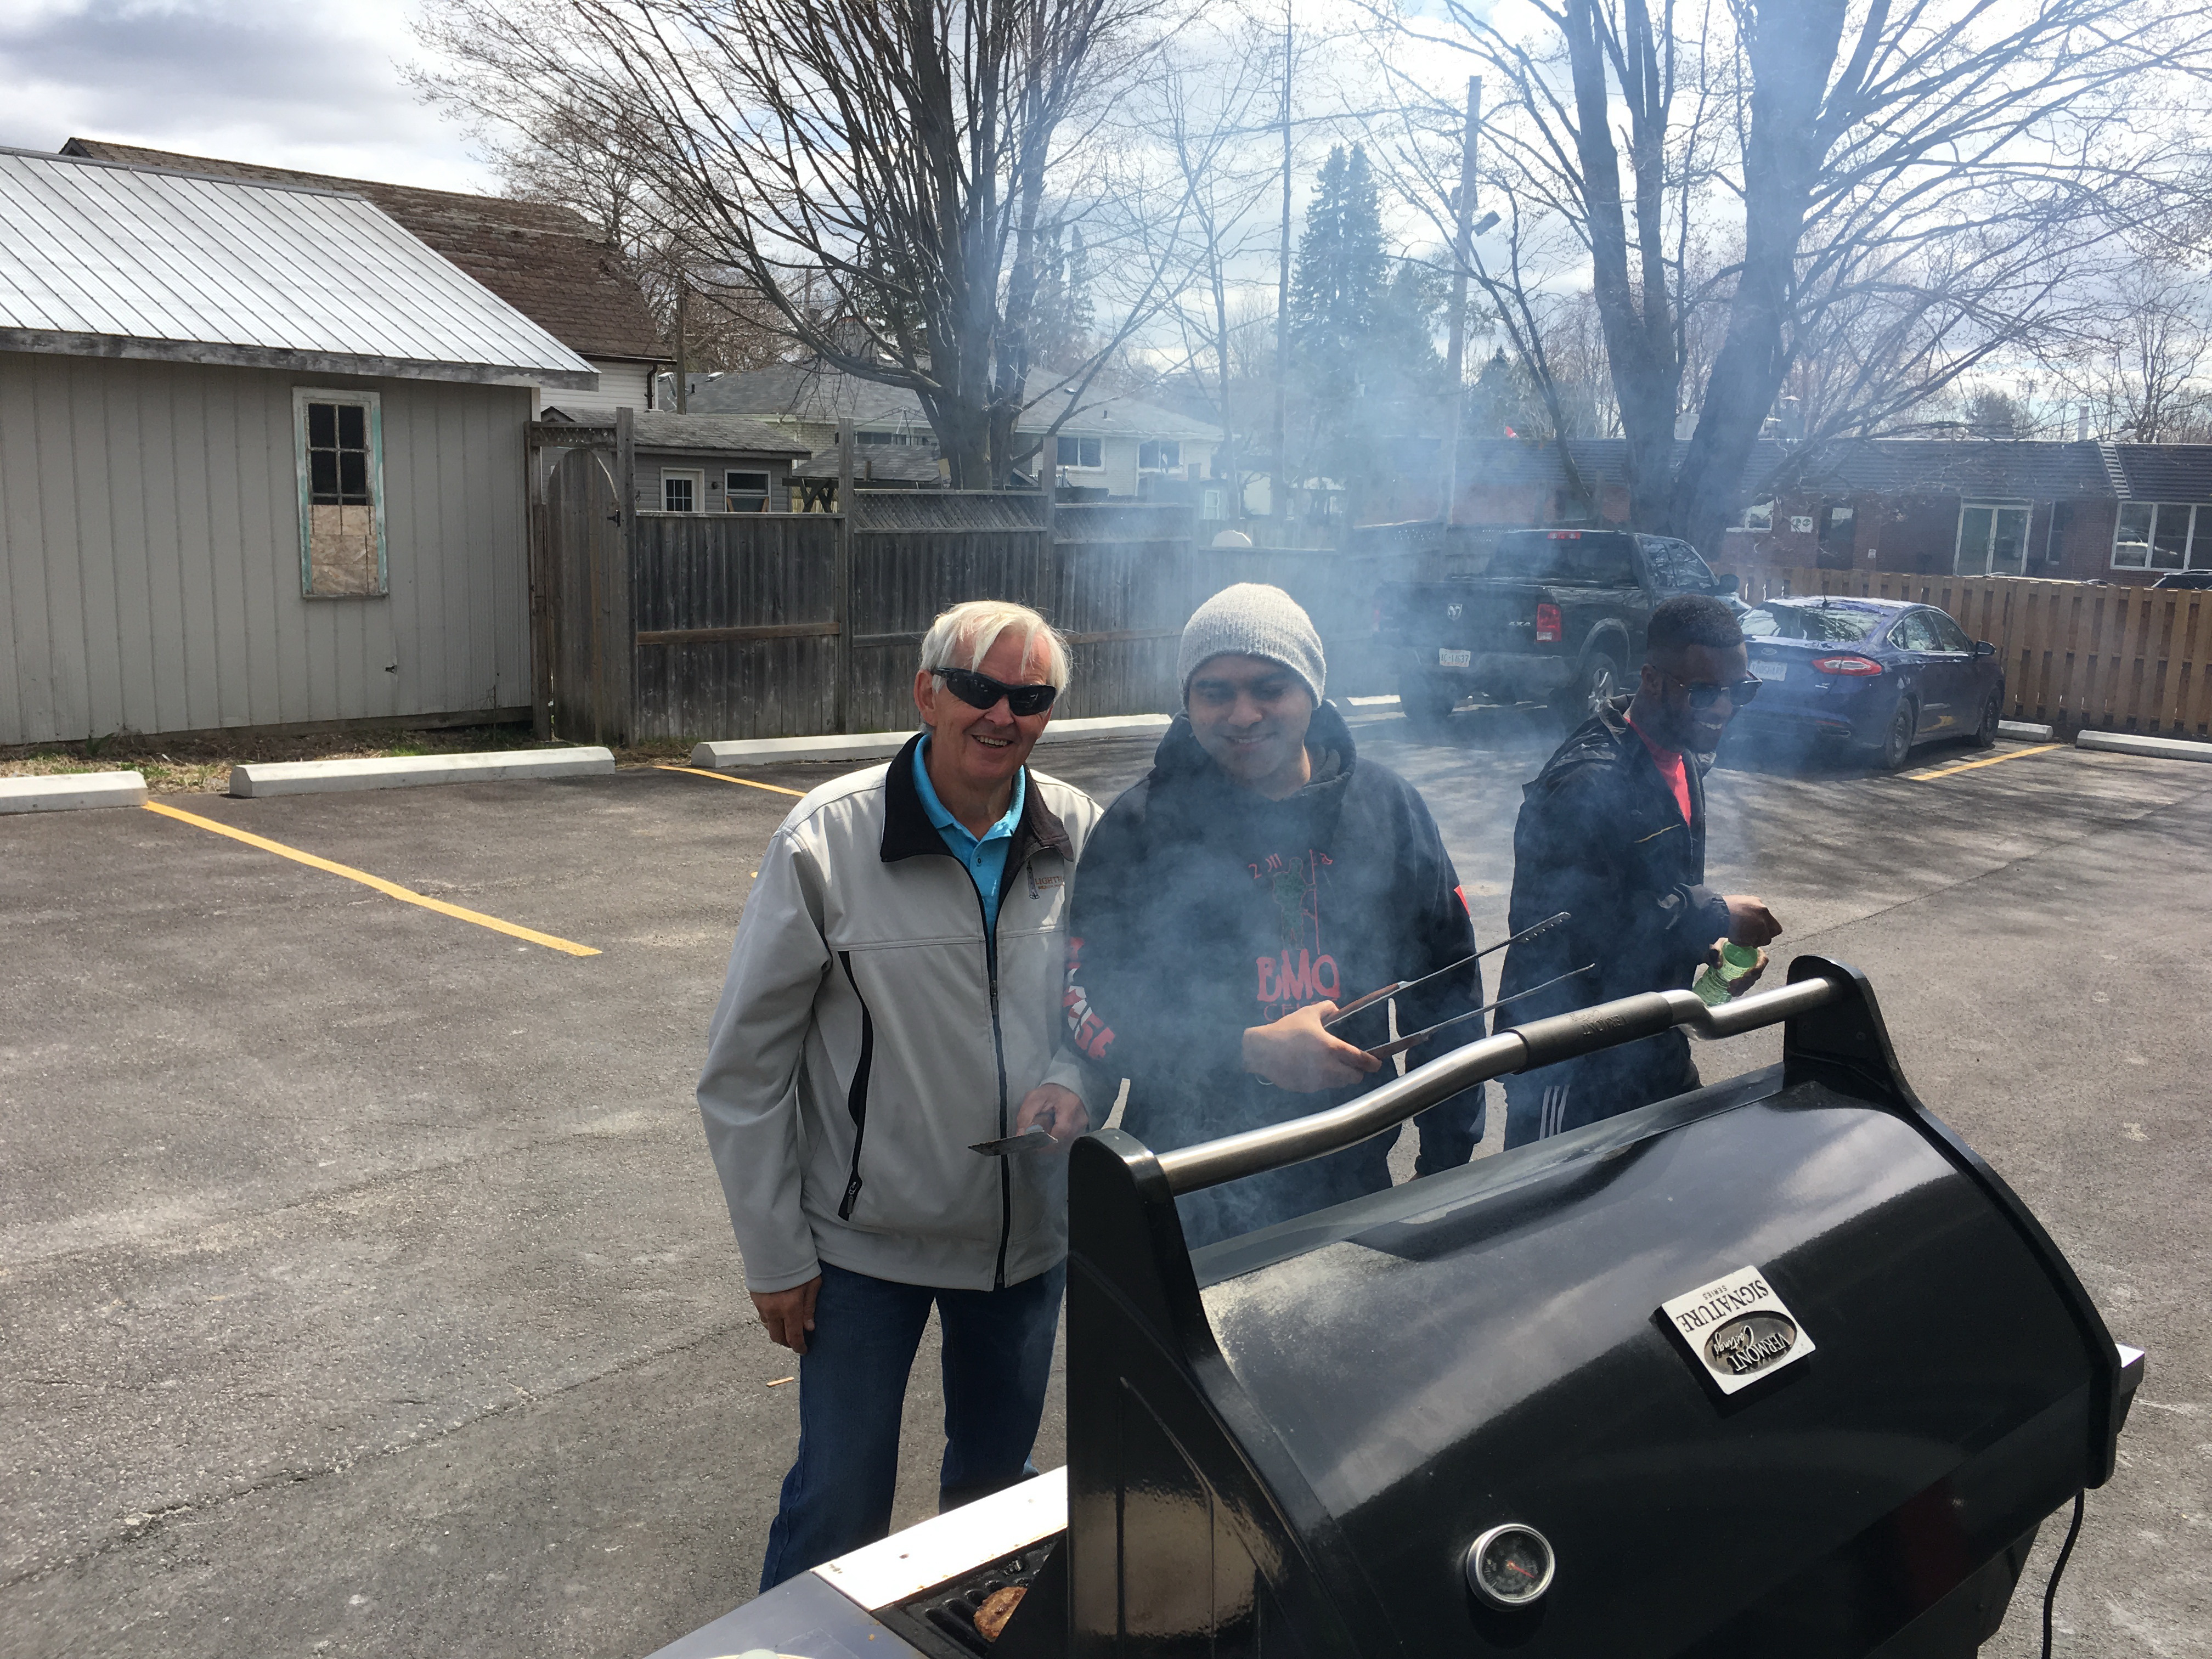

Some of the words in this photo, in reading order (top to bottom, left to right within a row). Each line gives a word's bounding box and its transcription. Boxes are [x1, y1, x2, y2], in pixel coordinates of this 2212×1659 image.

[1035, 876, 1063, 885] LIGHTH
[1581, 1015, 1627, 1035] VERMONT
[1702, 1284, 1728, 1301] SERIES
[1676, 1279, 1769, 1333] SIGNATURE
[1713, 1325, 1754, 1356] Castings
[1728, 1331, 1792, 1372] VERMONT
